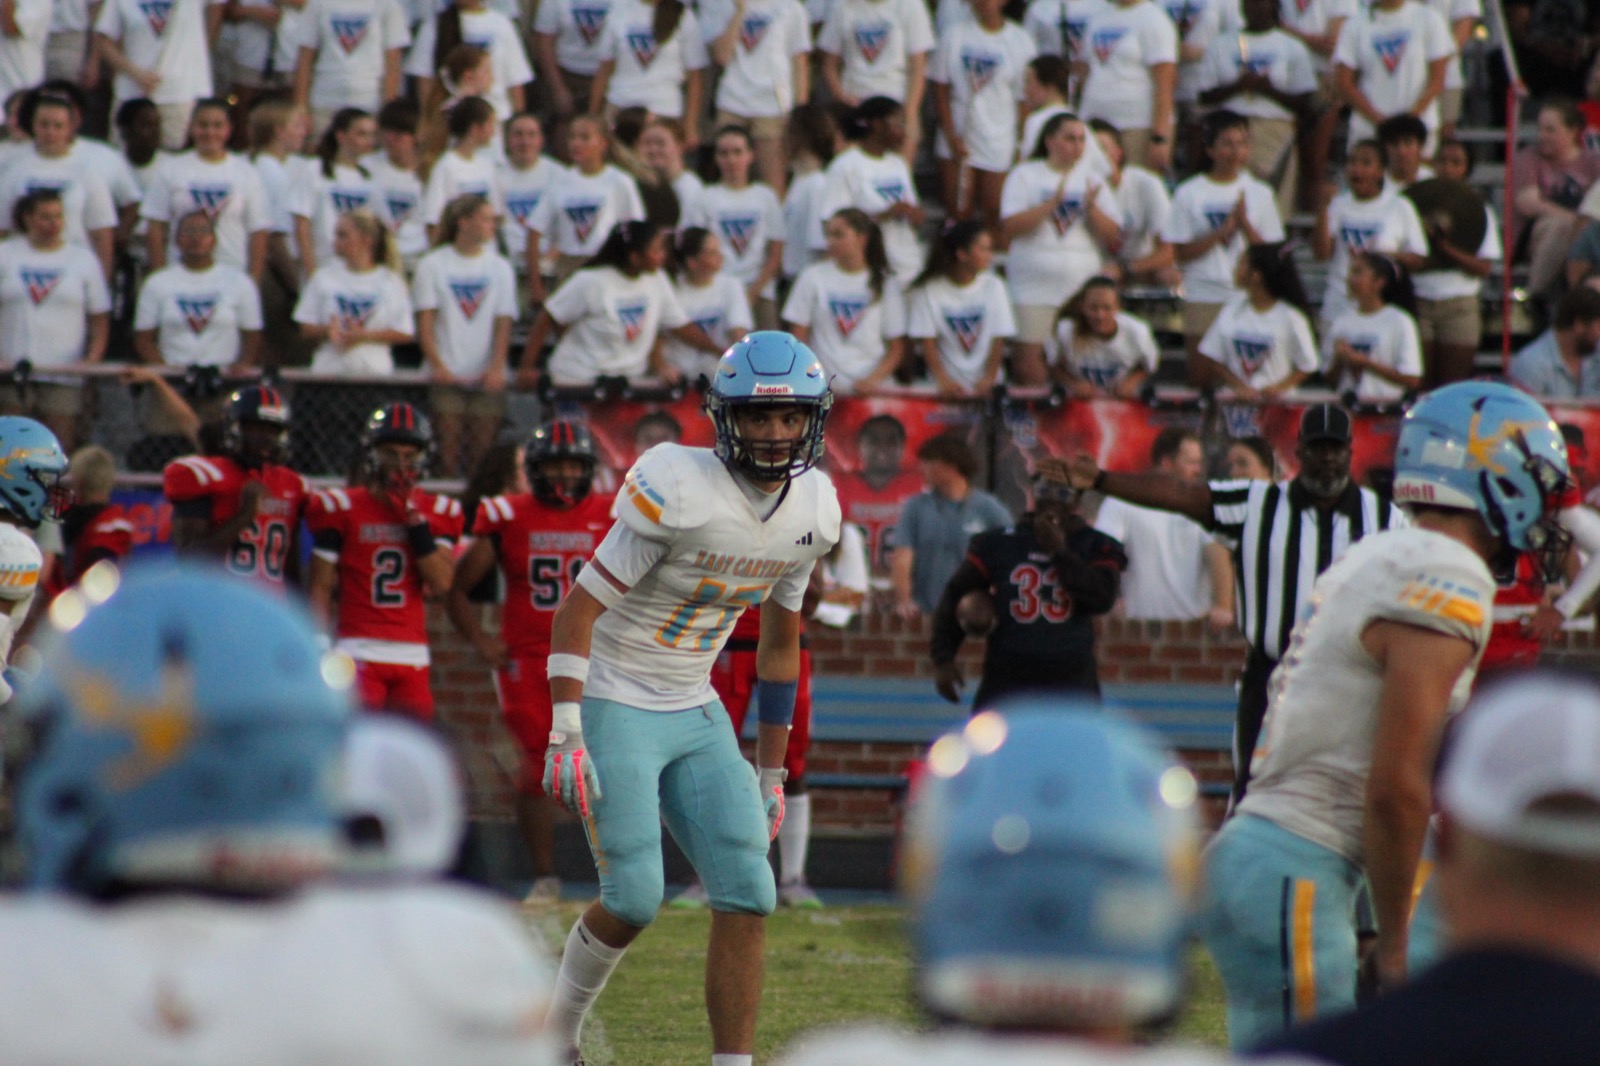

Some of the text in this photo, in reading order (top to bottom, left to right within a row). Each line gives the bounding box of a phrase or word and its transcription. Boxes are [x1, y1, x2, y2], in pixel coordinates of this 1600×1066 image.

[756, 386, 788, 394] Riddell
[225, 519, 289, 581] 60
[371, 546, 407, 608] 2
[692, 550, 735, 575] EAST
[1009, 563, 1072, 624] 33
